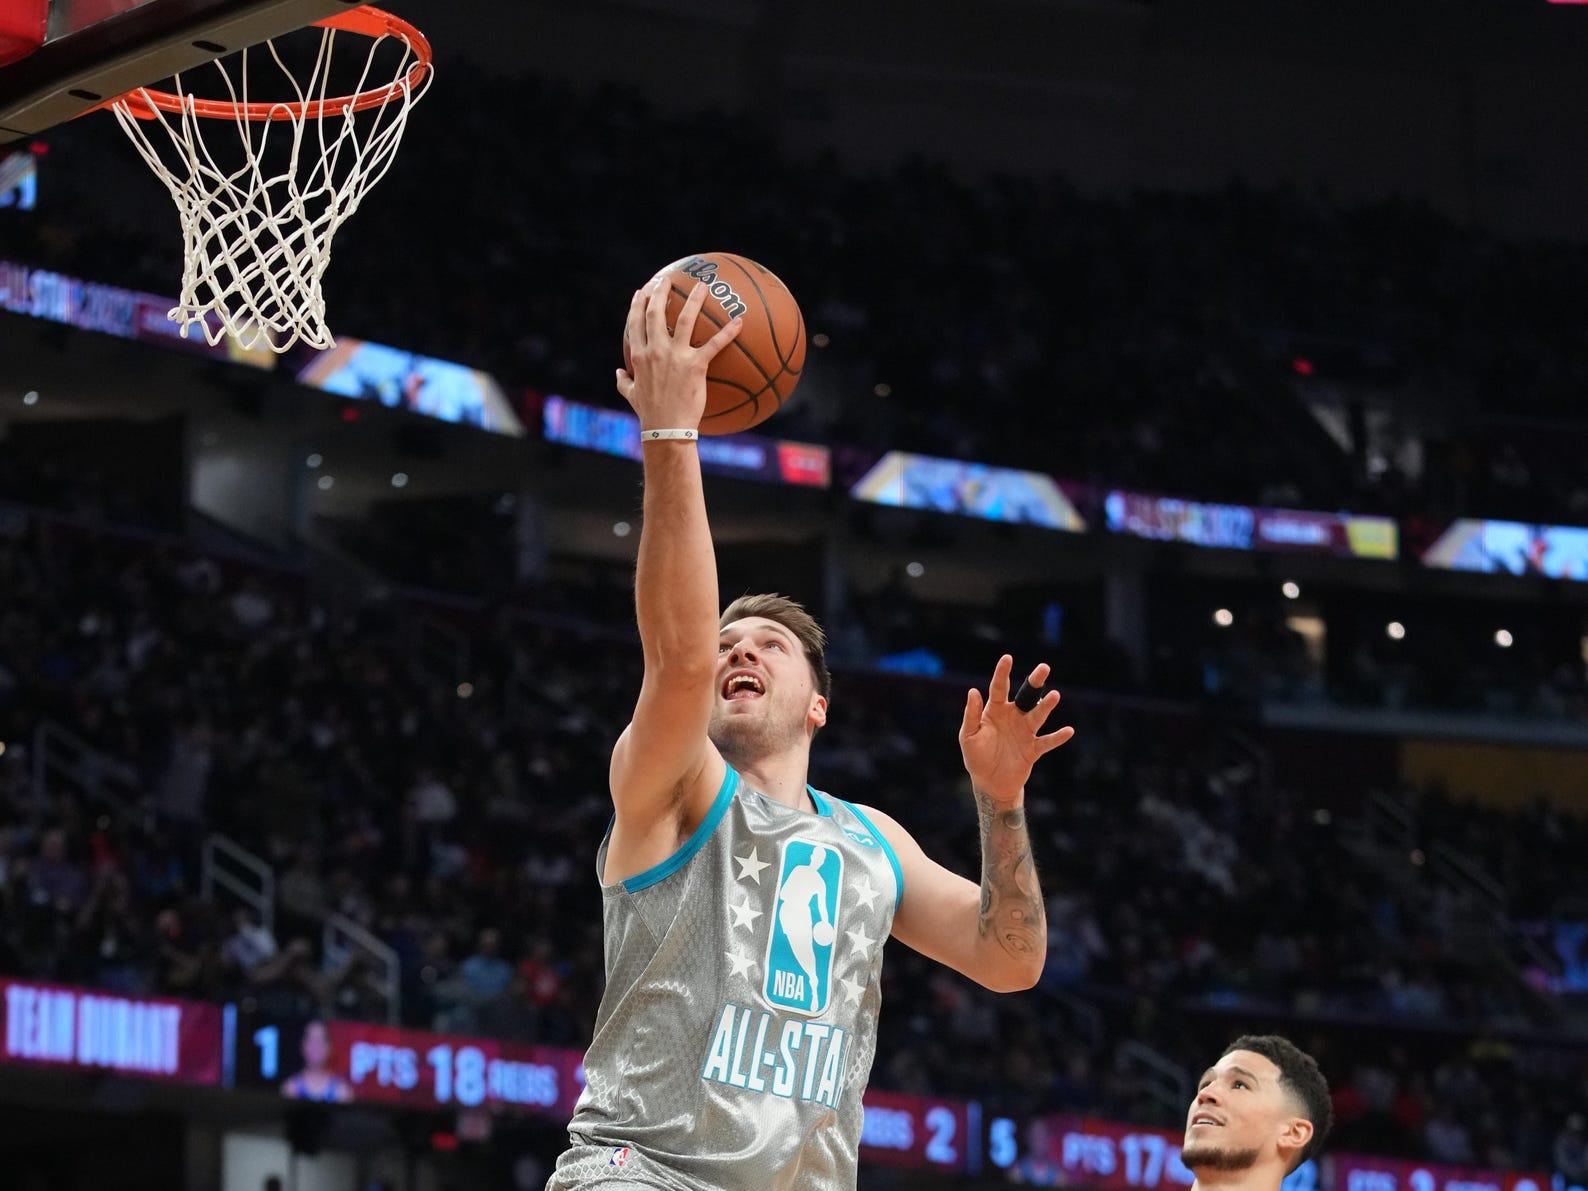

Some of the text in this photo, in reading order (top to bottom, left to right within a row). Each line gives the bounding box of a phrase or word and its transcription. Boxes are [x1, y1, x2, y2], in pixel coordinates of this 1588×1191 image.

[773, 969, 805, 1001] NBA
[254, 1025, 279, 1079] 1
[351, 1042, 418, 1089] PTS
[702, 1003, 852, 1110] ALL-STA
[925, 1106, 957, 1164] 2
[1062, 1131, 1116, 1176] PTS
[1122, 1133, 1166, 1187] 17
